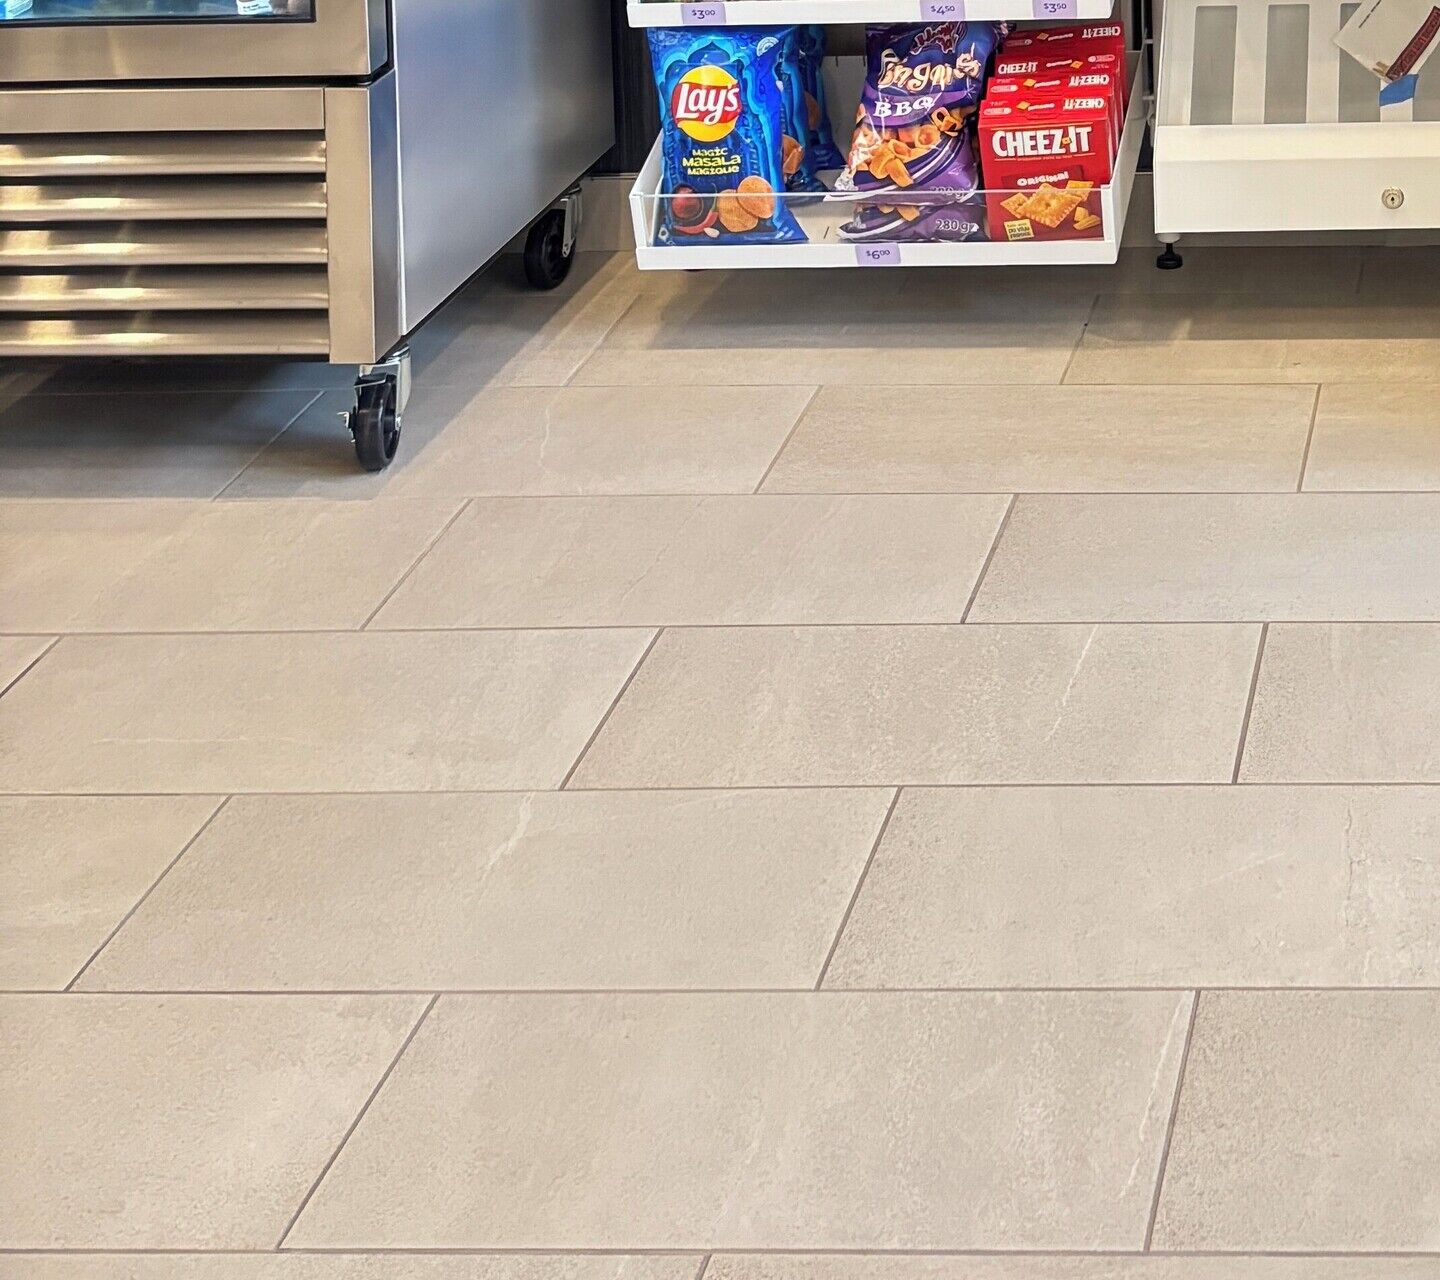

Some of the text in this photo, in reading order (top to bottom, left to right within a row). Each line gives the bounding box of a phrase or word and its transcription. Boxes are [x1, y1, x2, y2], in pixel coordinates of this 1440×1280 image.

[676, 83, 741, 125] Lay's
[873, 94, 935, 118] BBQ
[991, 126, 1092, 158] CHEEZ-IT
[935, 219, 959, 231] 280
